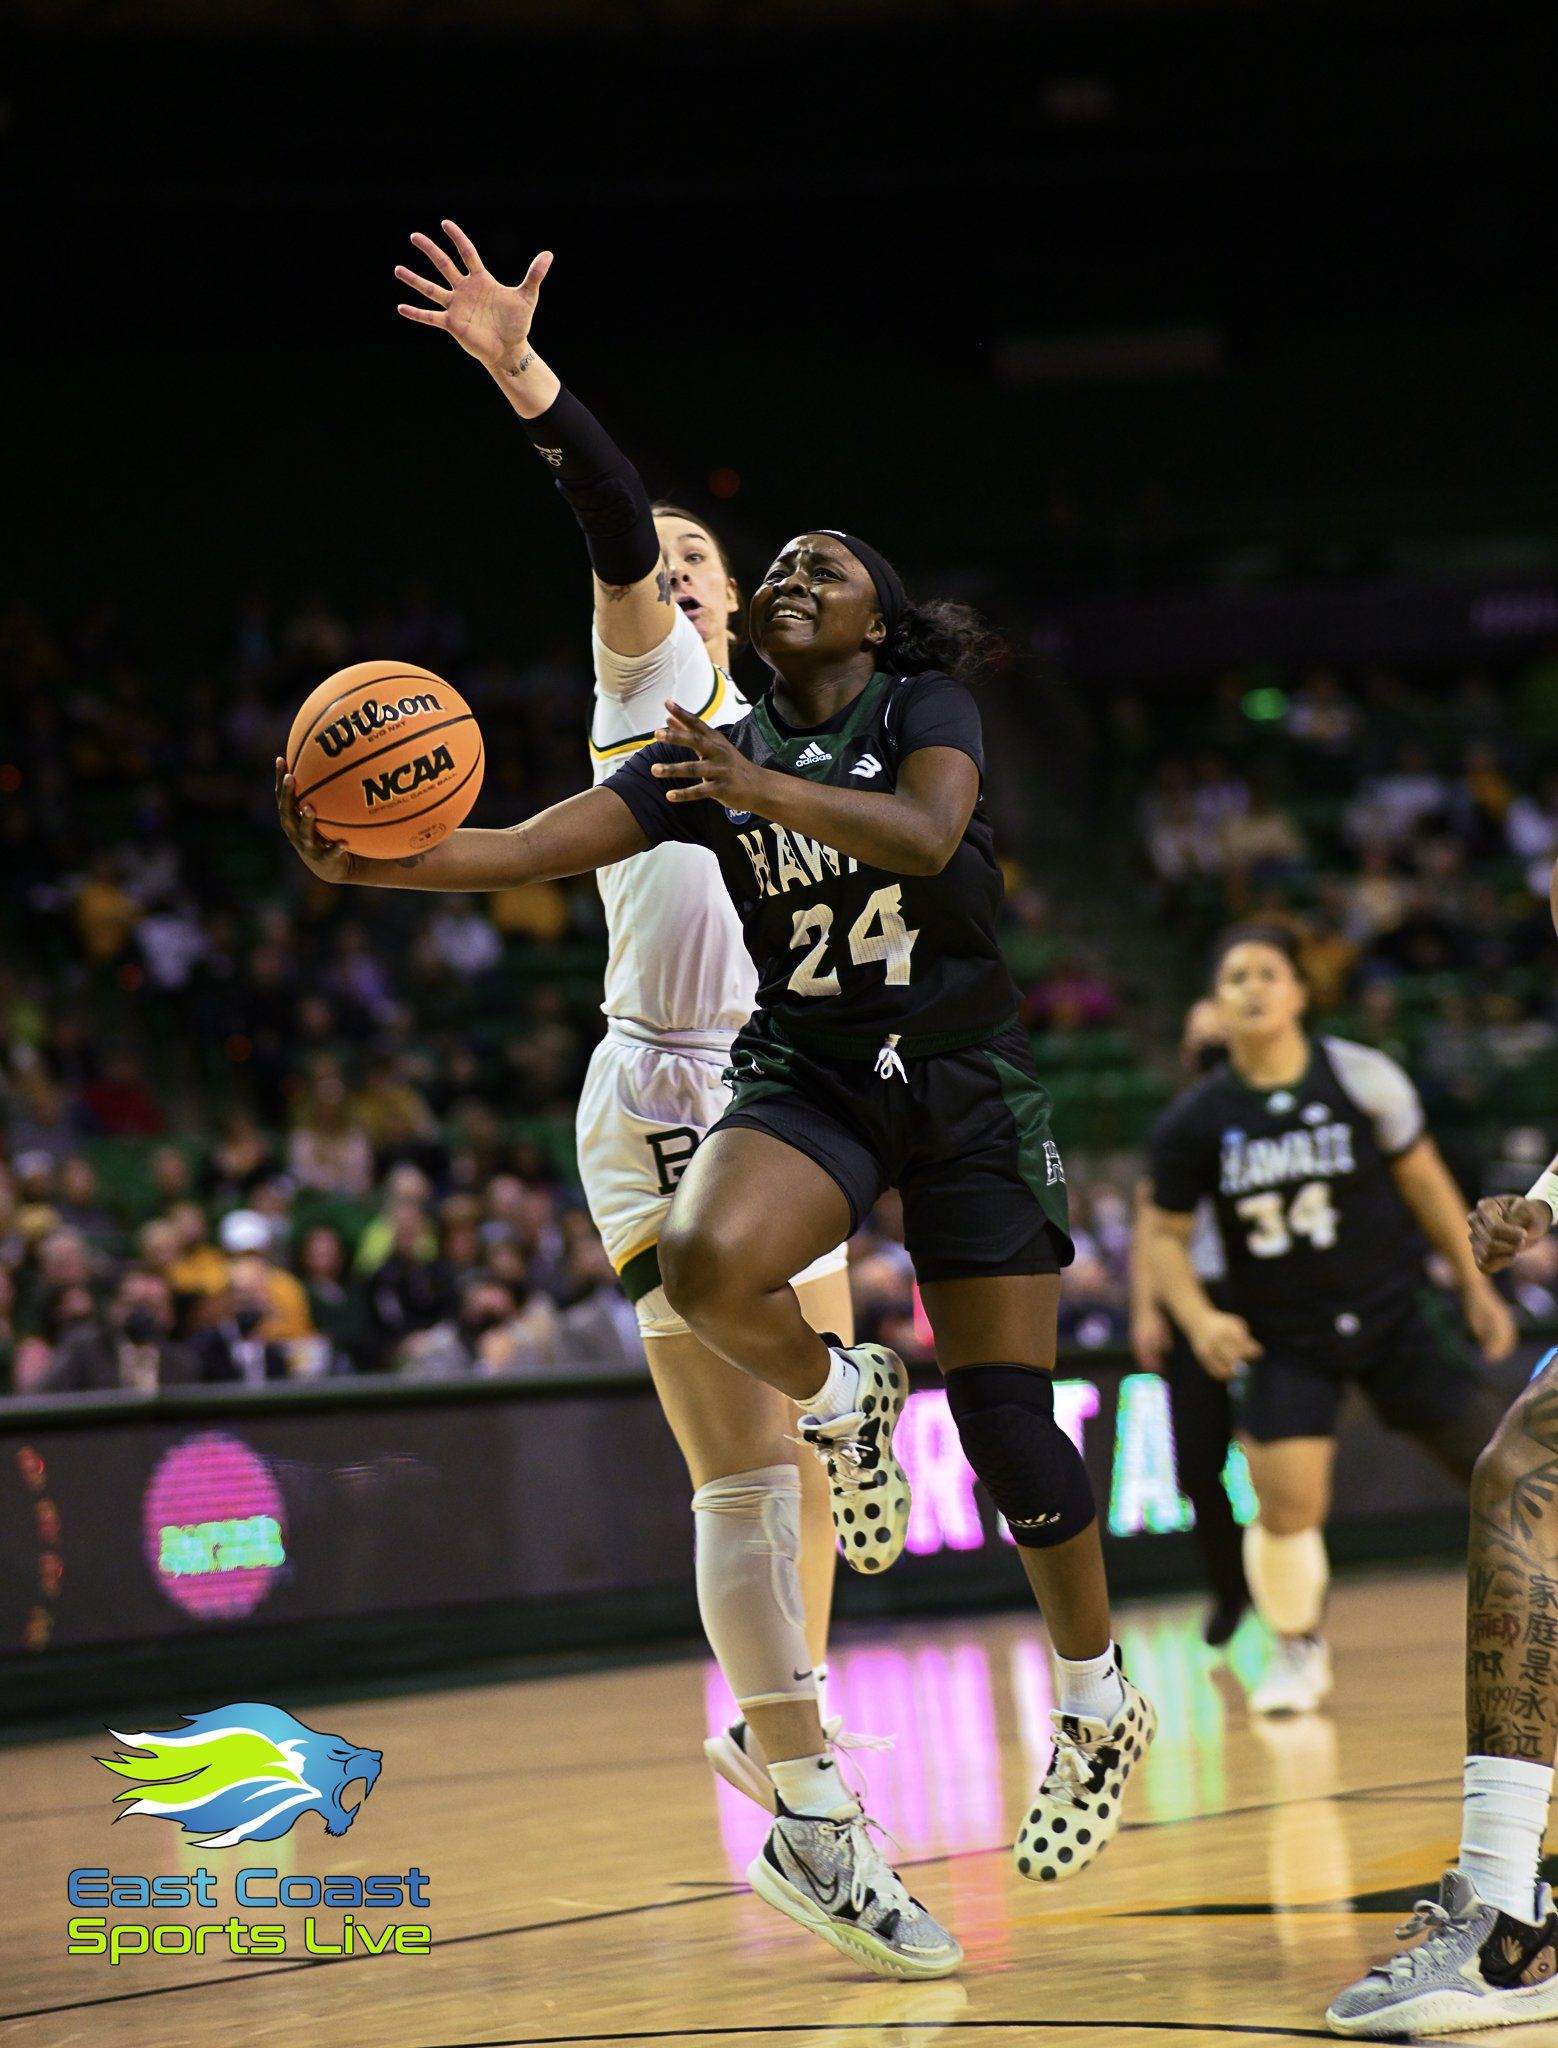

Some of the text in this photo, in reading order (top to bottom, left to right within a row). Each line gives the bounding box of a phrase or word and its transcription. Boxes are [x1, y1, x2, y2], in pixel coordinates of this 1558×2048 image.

[315, 693, 443, 758] Wilson
[362, 744, 455, 807] NCAA
[795, 752, 833, 768] adidas
[787, 883, 920, 998] 24
[1235, 1181, 1340, 1258] 34
